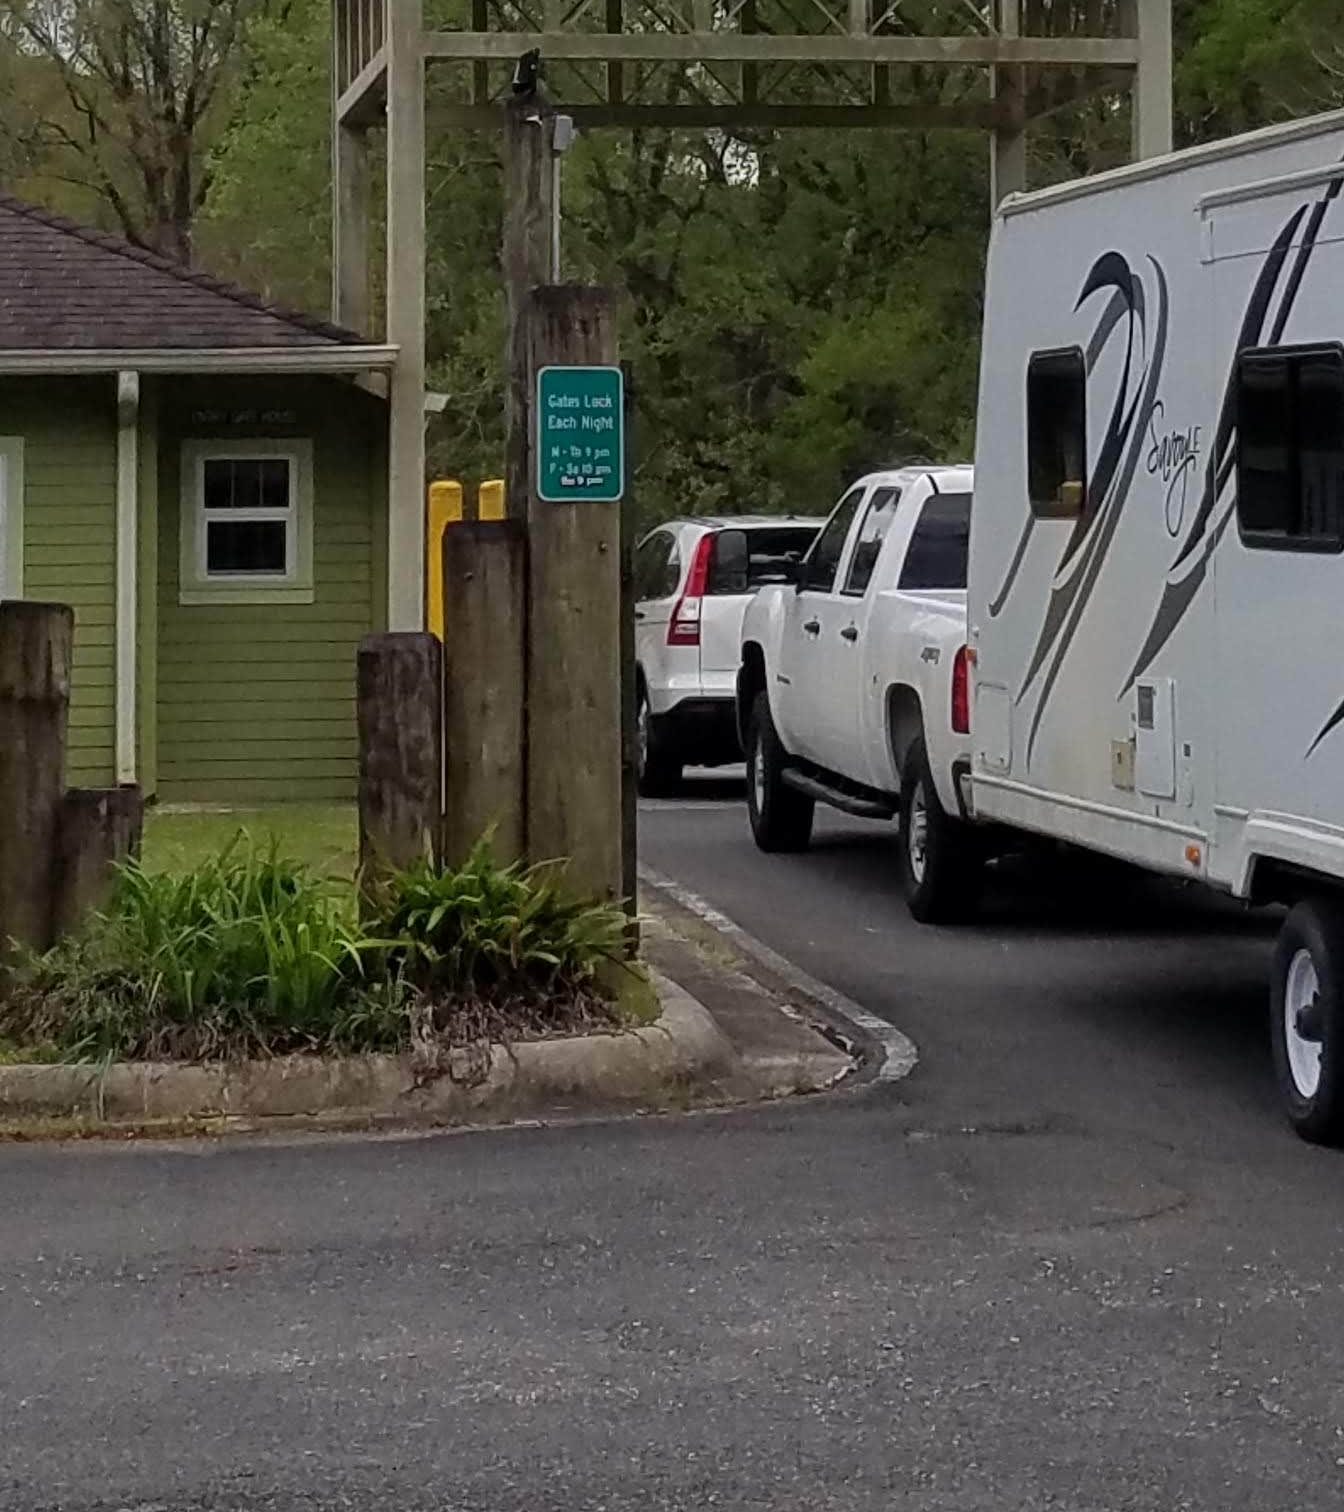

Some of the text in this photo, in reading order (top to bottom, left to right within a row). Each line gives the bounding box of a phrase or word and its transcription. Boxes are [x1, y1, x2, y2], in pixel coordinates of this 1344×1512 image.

[548, 395, 613, 408] Gates Lock
[548, 415, 614, 432] Each Night
